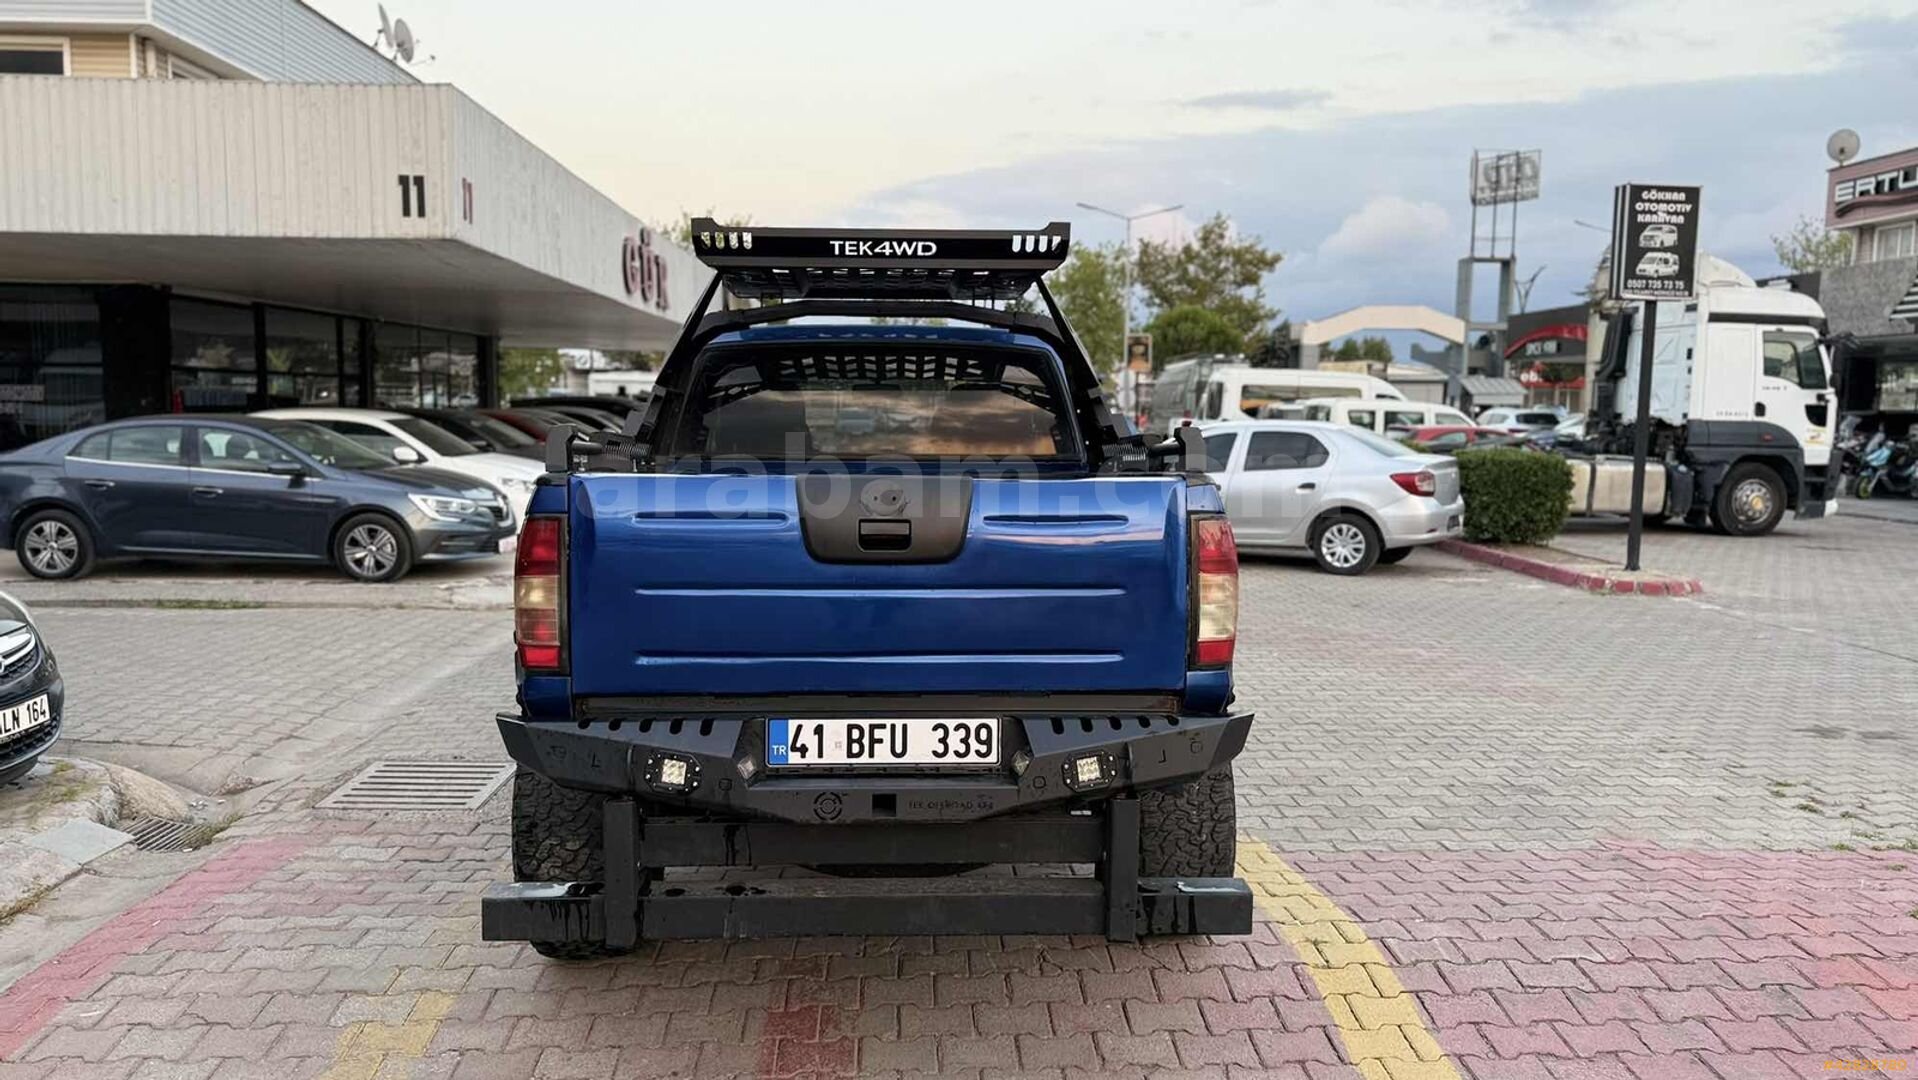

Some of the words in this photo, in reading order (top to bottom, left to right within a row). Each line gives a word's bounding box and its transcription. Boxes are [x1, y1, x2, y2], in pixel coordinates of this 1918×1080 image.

[398, 174, 426, 218] 11
[462, 177, 473, 225] 11
[1642, 189, 1686, 201] GÖKHAN
[1834, 166, 1918, 203] ERTU
[829, 240, 937, 256] TEK4WD
[622, 227, 671, 311] GÜR
[0, 707, 20, 735] LN
[27, 698, 47, 724] 164
[772, 745, 787, 756] TR
[790, 723, 824, 759] 41
[846, 723, 908, 759] BFU
[931, 722, 993, 759] 339
